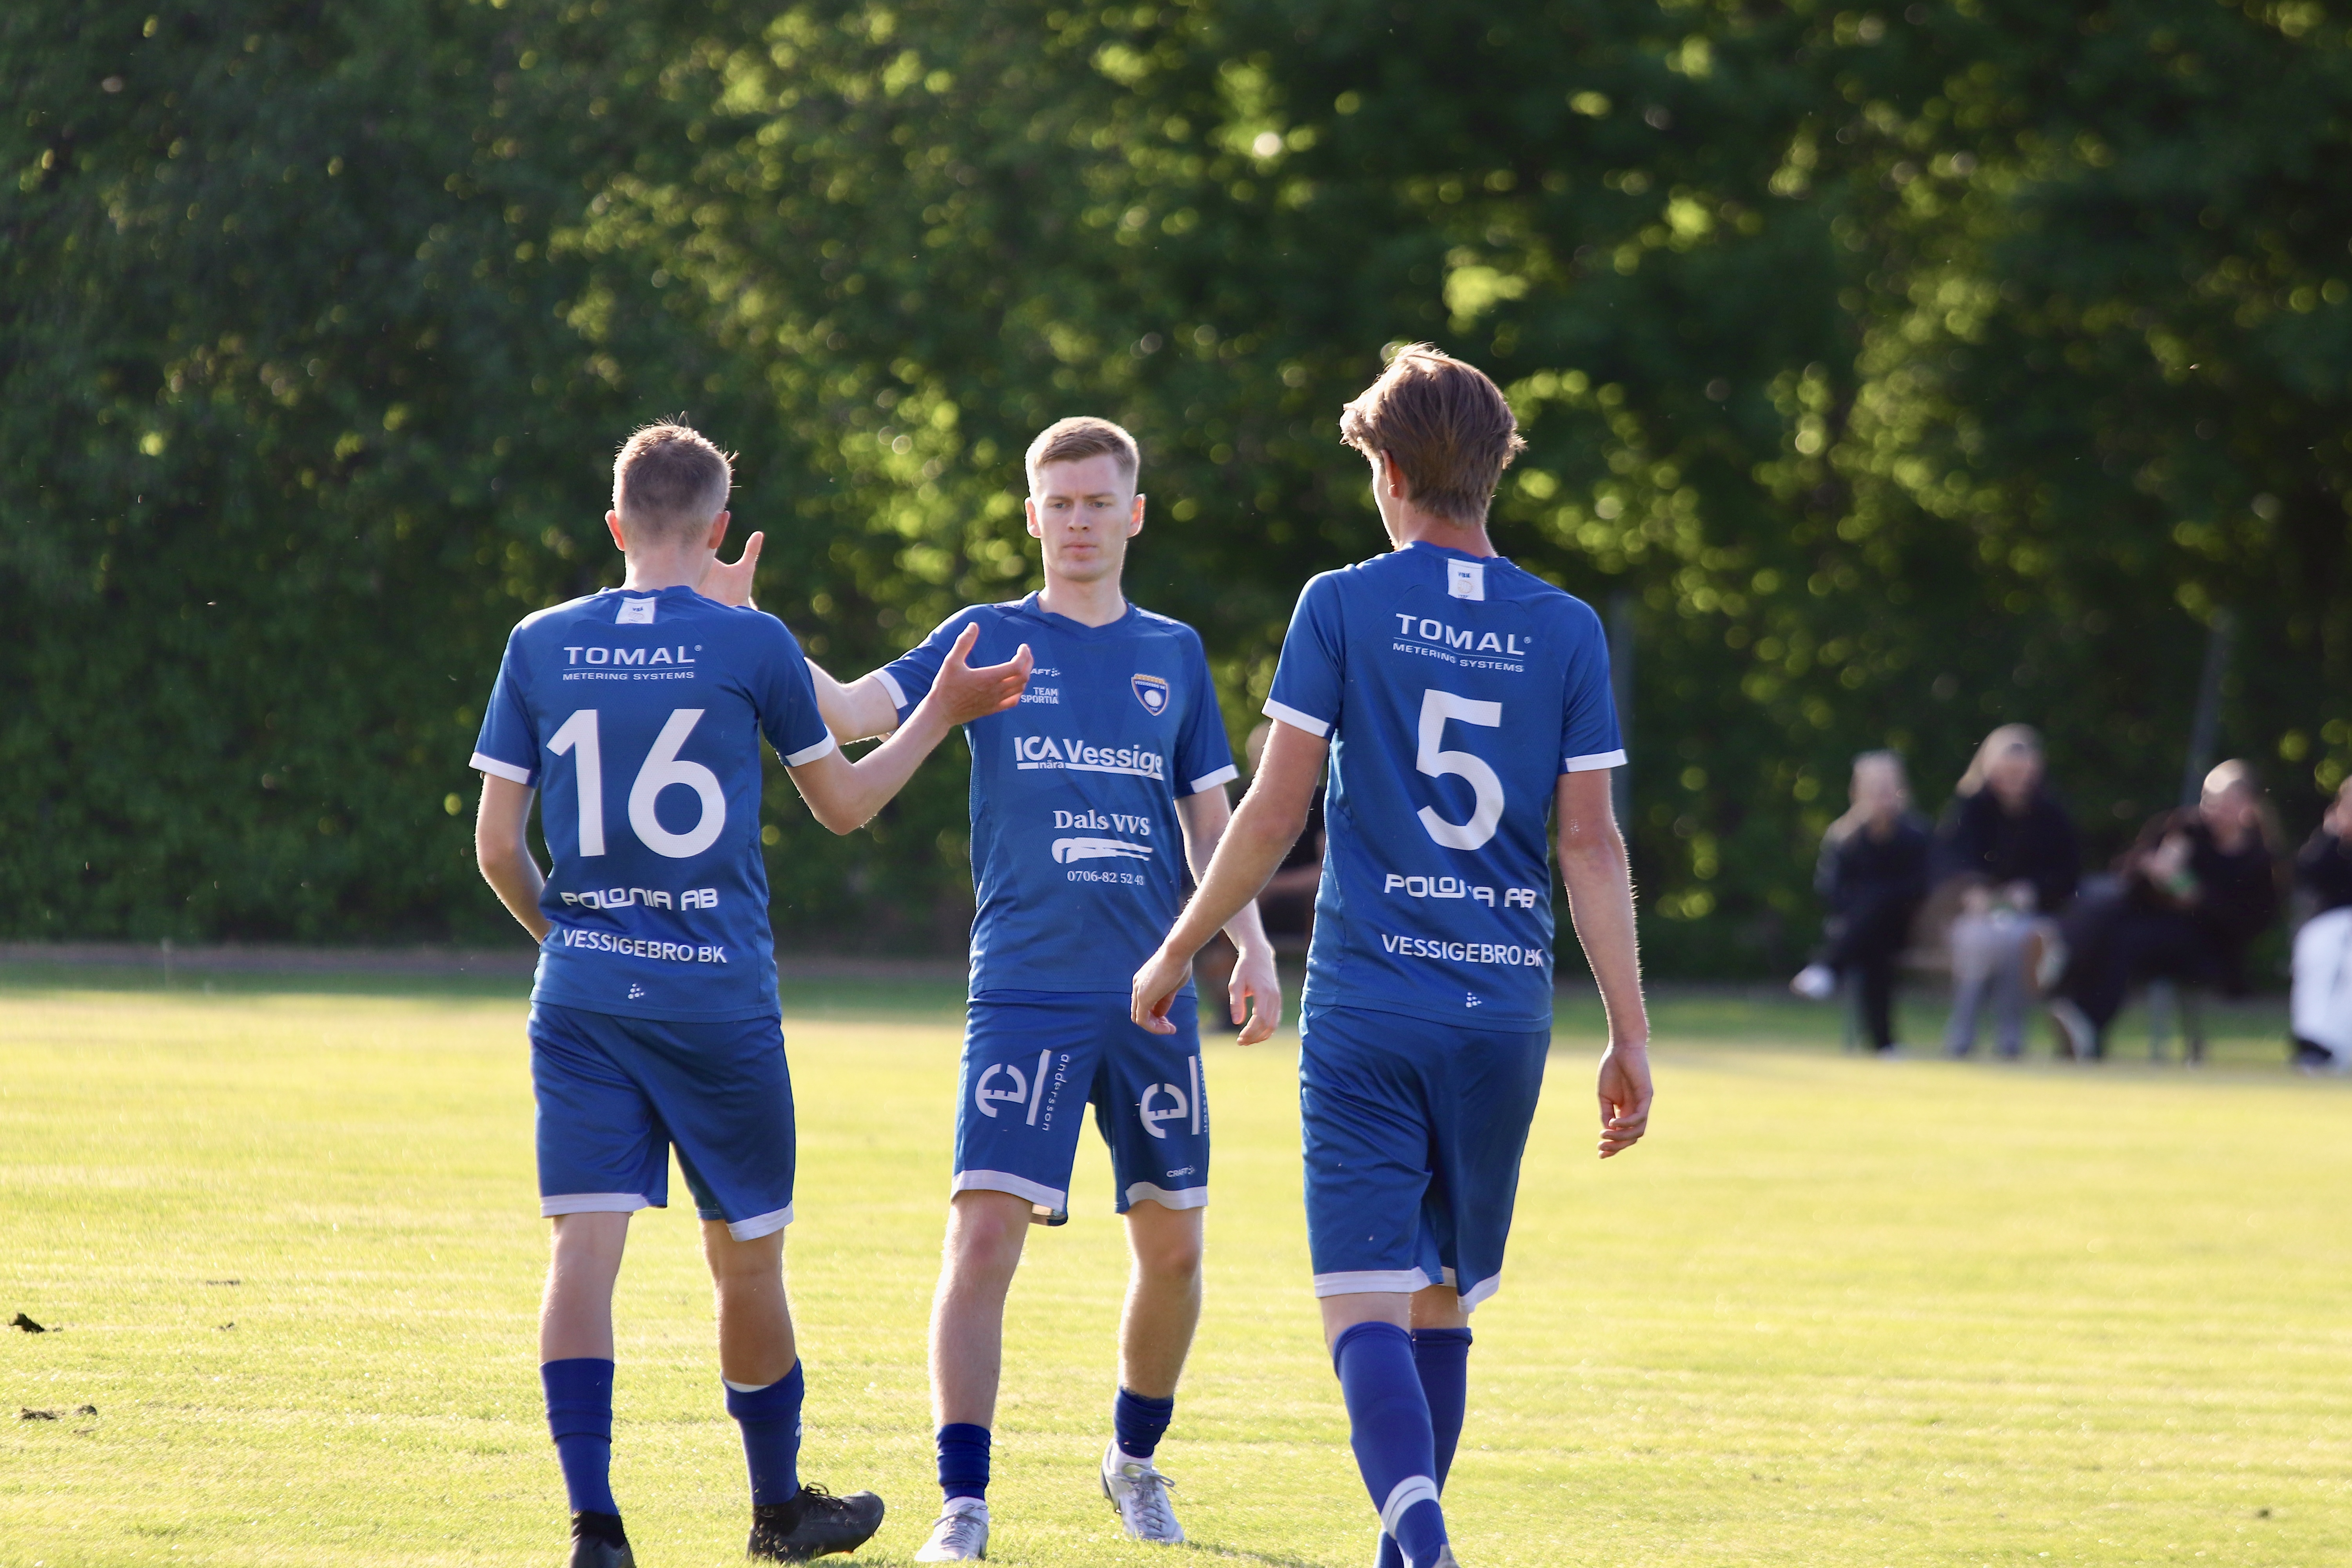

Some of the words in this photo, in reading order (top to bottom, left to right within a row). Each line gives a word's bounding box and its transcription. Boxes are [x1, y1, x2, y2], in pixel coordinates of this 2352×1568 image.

[1392, 642, 1456, 664] METERING
[1459, 659, 1523, 672] SYSTEMS
[563, 672, 627, 681] METERING
[633, 671, 694, 681] SYSTEMS
[1020, 694, 1059, 704] SPORTIA
[1033, 687, 1058, 696] TEAM
[1014, 735, 1063, 761] ICA
[1039, 760, 1065, 769] nära
[1416, 688, 1505, 851] 5
[546, 708, 726, 858] 16
[1053, 809, 1109, 830] Dals
[1110, 813, 1151, 836] VVS
[1067, 871, 1117, 883] 0706-82
[1120, 873, 1132, 884] 52
[1134, 875, 1144, 886] 43
[560, 887, 672, 911] POLONIA
[680, 887, 719, 911] AB
[562, 929, 694, 962] VESSIGEBRO
[698, 945, 728, 964] BK
[1381, 934, 1522, 966] VESSIGEBRO
[1042, 1053, 1069, 1132] andersson
[1166, 1167, 1189, 1178] CRAFT
